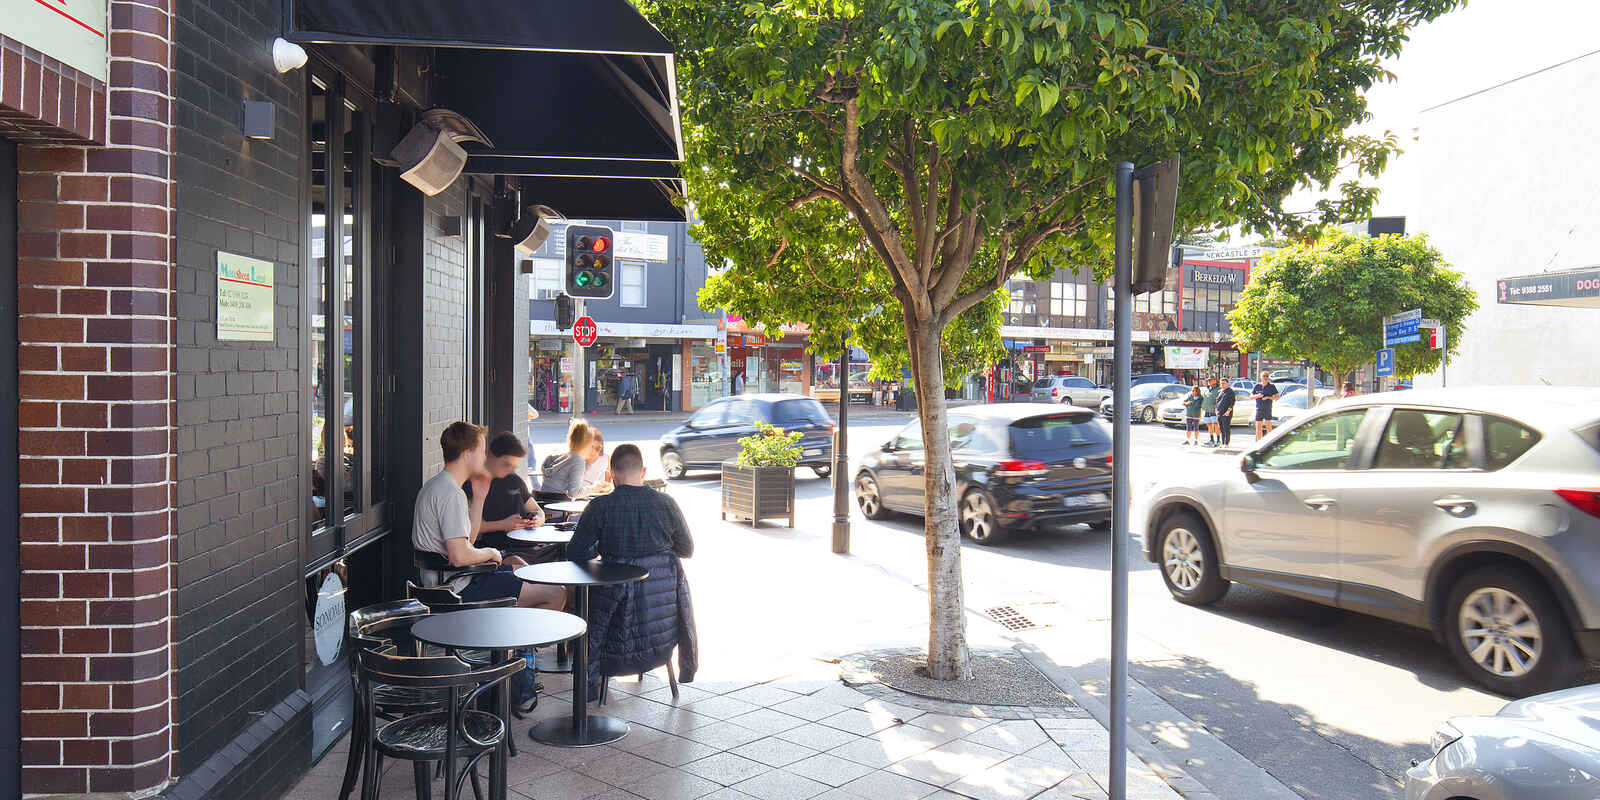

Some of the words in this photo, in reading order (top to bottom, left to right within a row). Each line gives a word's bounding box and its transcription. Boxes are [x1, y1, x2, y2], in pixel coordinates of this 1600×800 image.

[1206, 250, 1249, 258] NEWCASTLE
[1194, 270, 1237, 285] BERKELOUW
[575, 326, 595, 337] STOP
[1380, 351, 1388, 366] P
